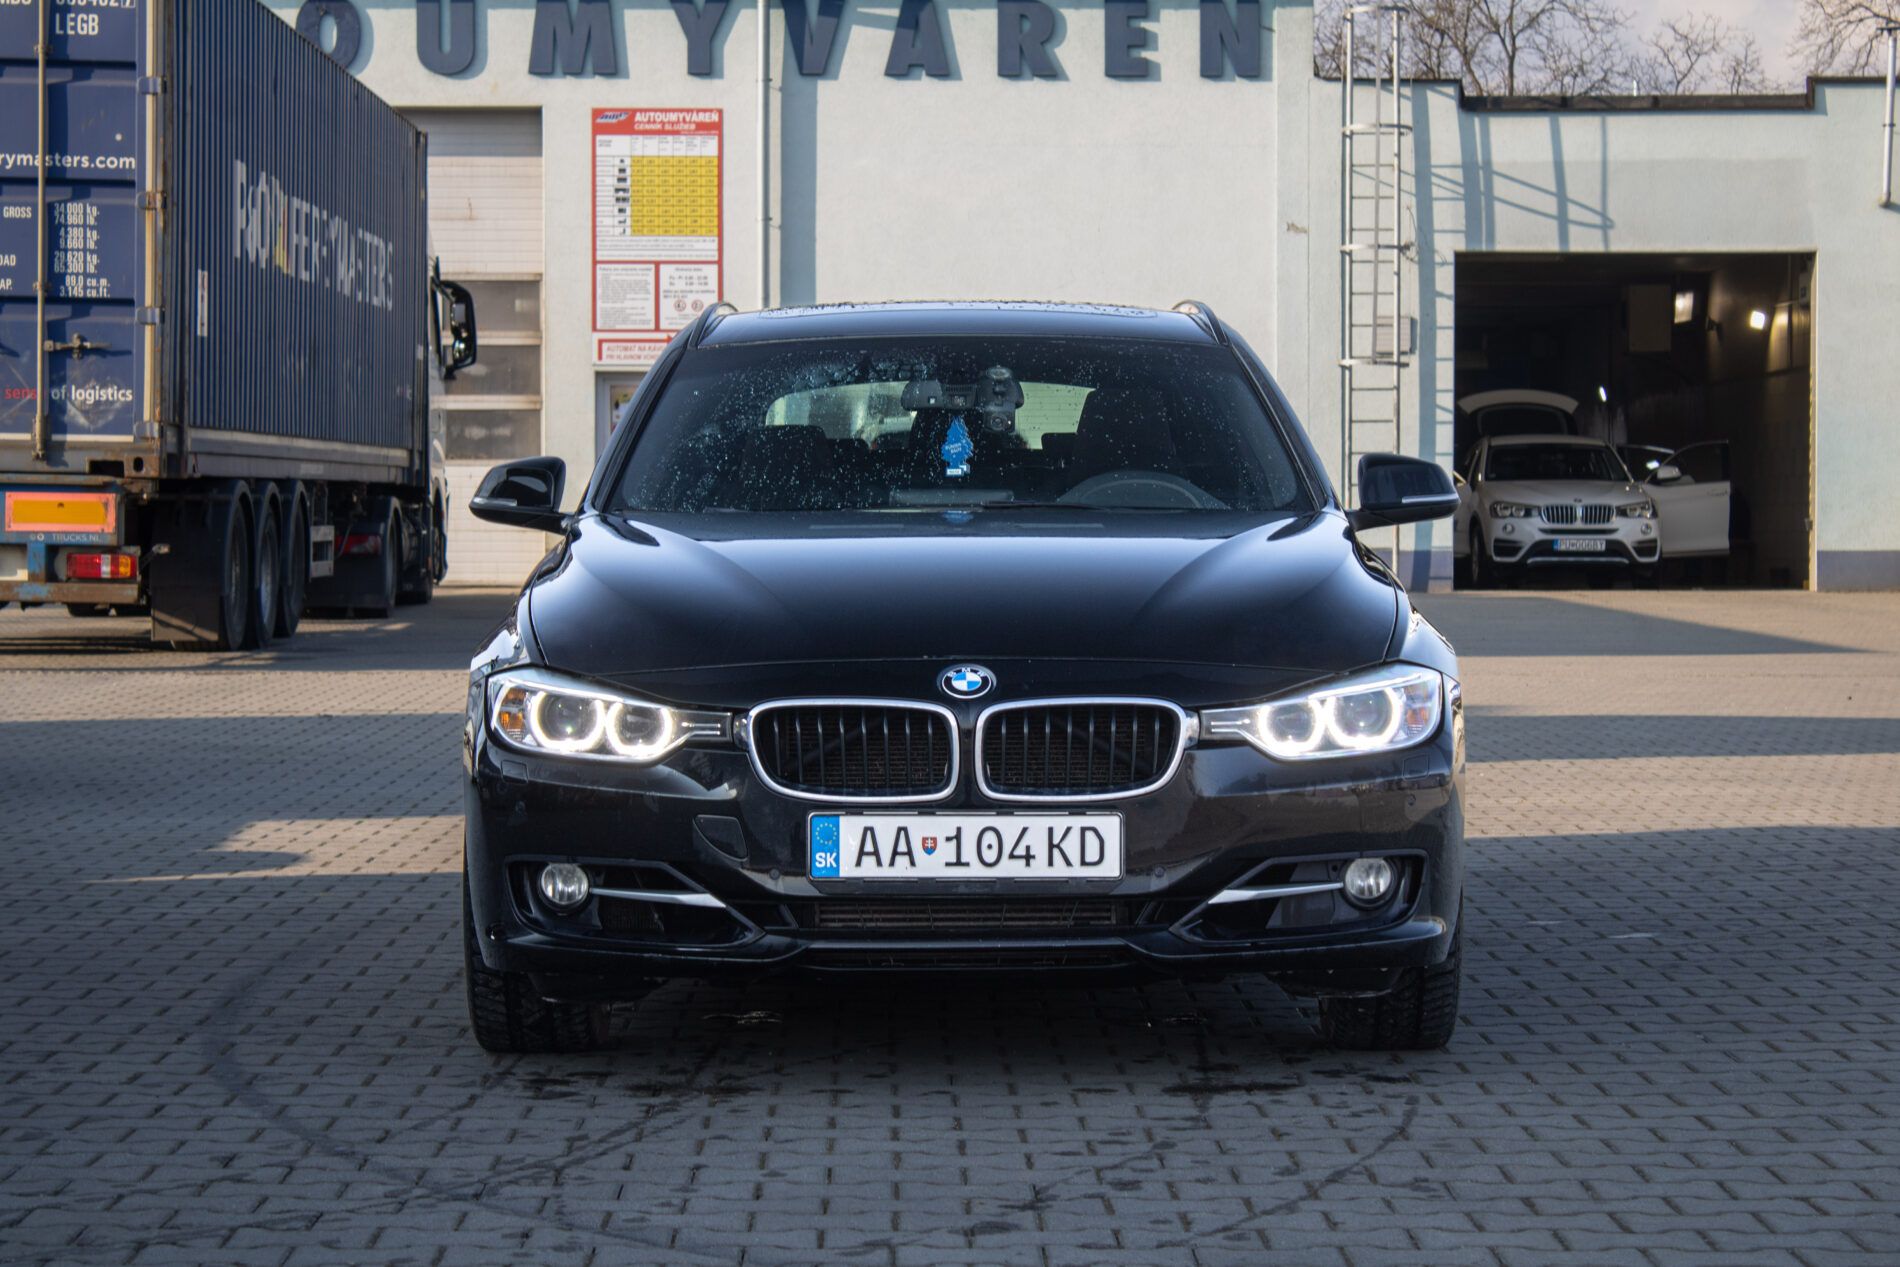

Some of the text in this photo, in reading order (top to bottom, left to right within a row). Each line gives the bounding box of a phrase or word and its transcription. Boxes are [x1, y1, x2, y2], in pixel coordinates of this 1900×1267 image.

[3, 206, 32, 218] GROSS
[51, 385, 66, 401] of
[71, 384, 133, 404] logistics
[947, 667, 988, 677] BMW
[855, 826, 1105, 868] AA 104KD
[815, 852, 837, 868] SK
